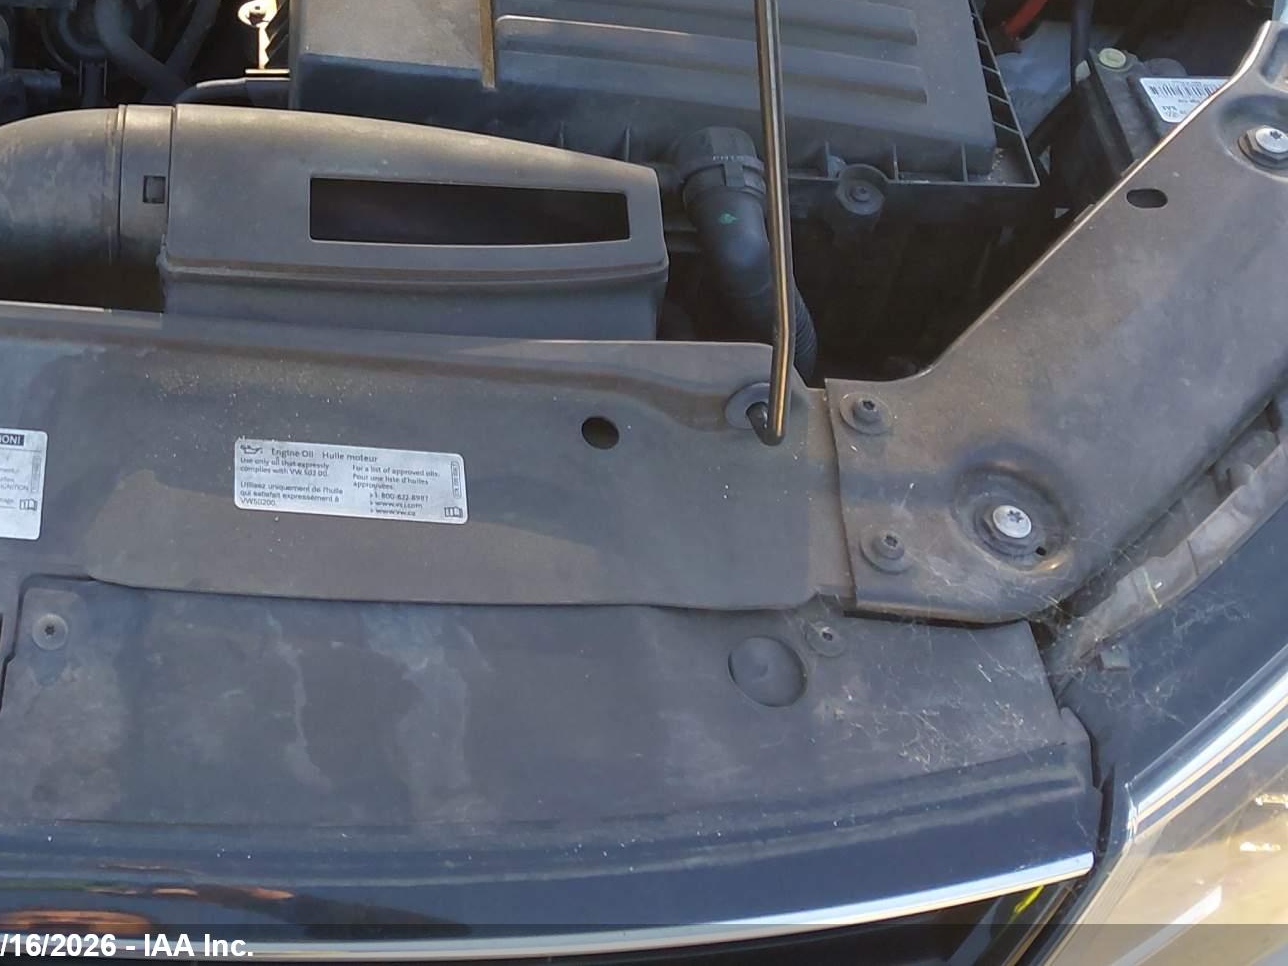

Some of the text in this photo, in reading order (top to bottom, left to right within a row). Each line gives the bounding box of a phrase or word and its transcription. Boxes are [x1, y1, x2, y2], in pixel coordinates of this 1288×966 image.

[271, 448, 377, 462] Engine Oil Huile moteur
[240, 466, 270, 474] complies
[297, 460, 329, 470] expressly
[391, 467, 424, 477] approved
[268, 483, 309, 493] uniquement
[282, 492, 332, 502] expressément
